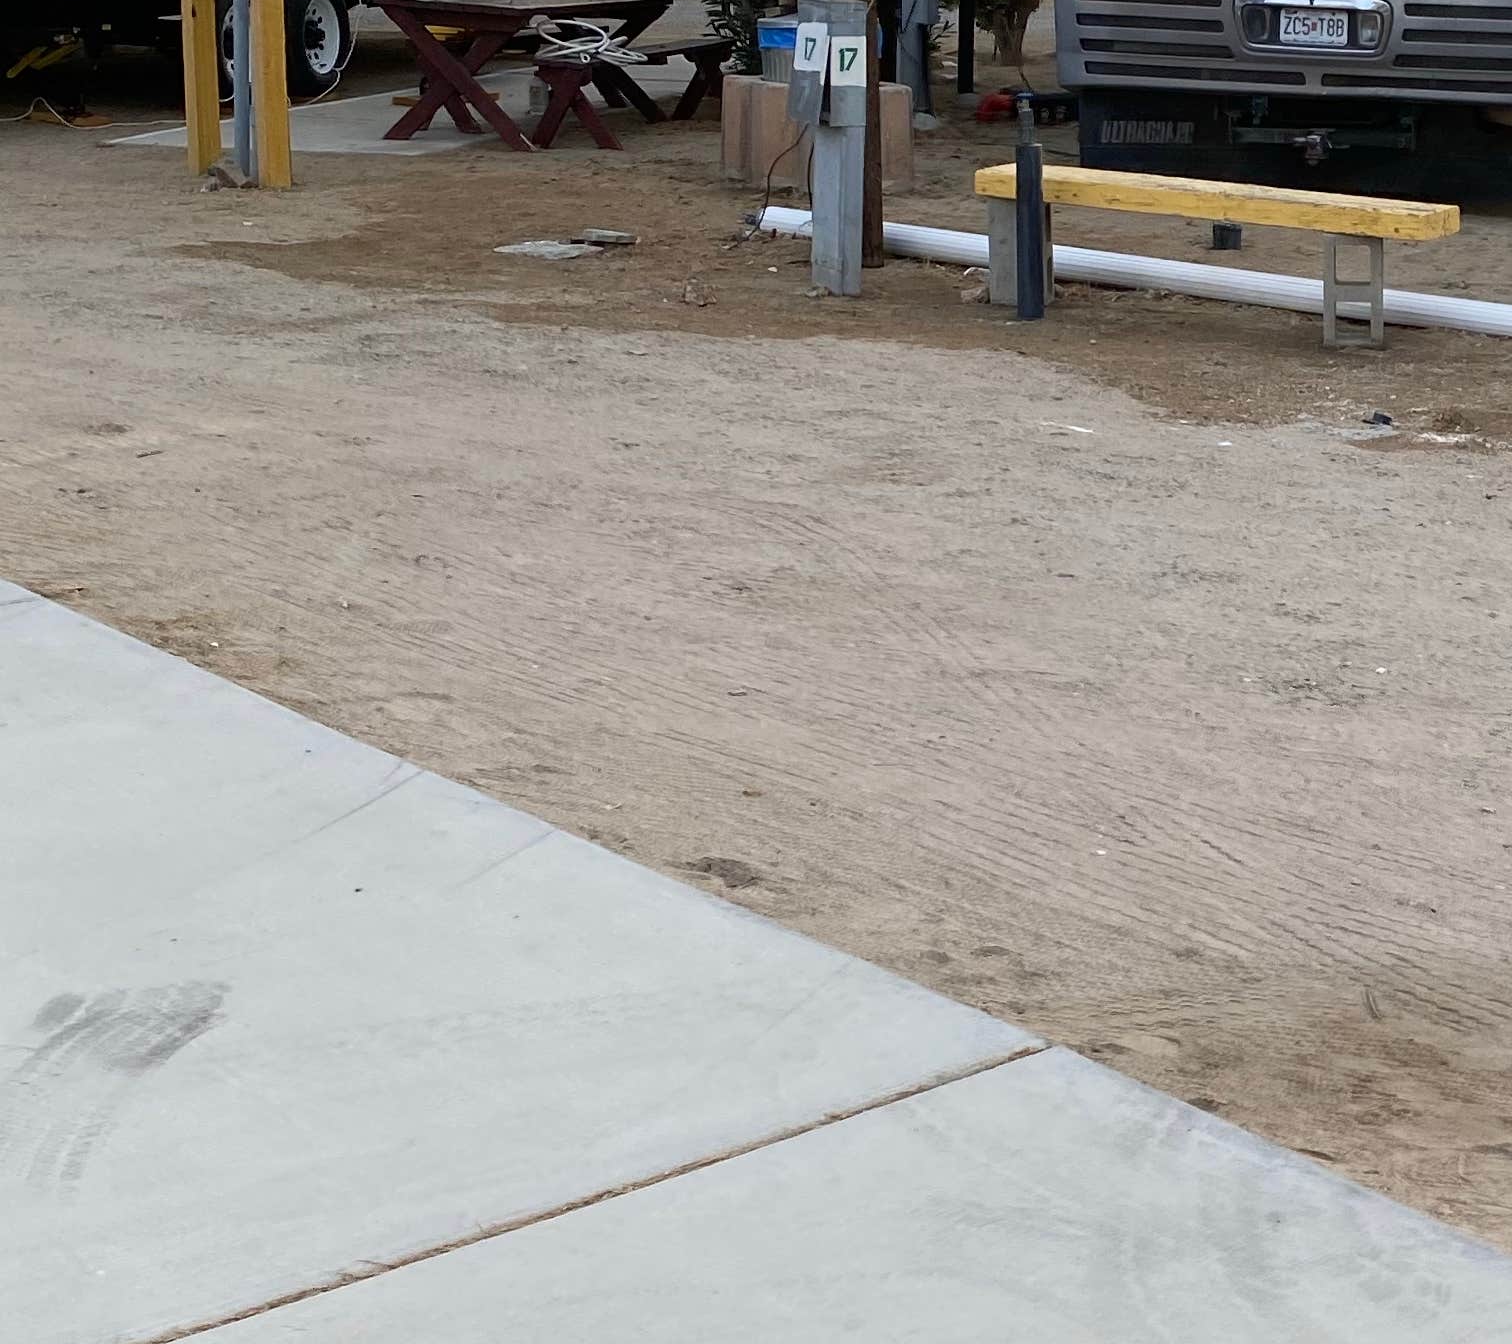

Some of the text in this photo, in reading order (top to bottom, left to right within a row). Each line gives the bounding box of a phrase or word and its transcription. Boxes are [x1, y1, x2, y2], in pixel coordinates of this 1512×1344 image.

[1283, 16, 1311, 35] ZC5
[804, 37, 817, 61] 17
[838, 47, 858, 72] 17
